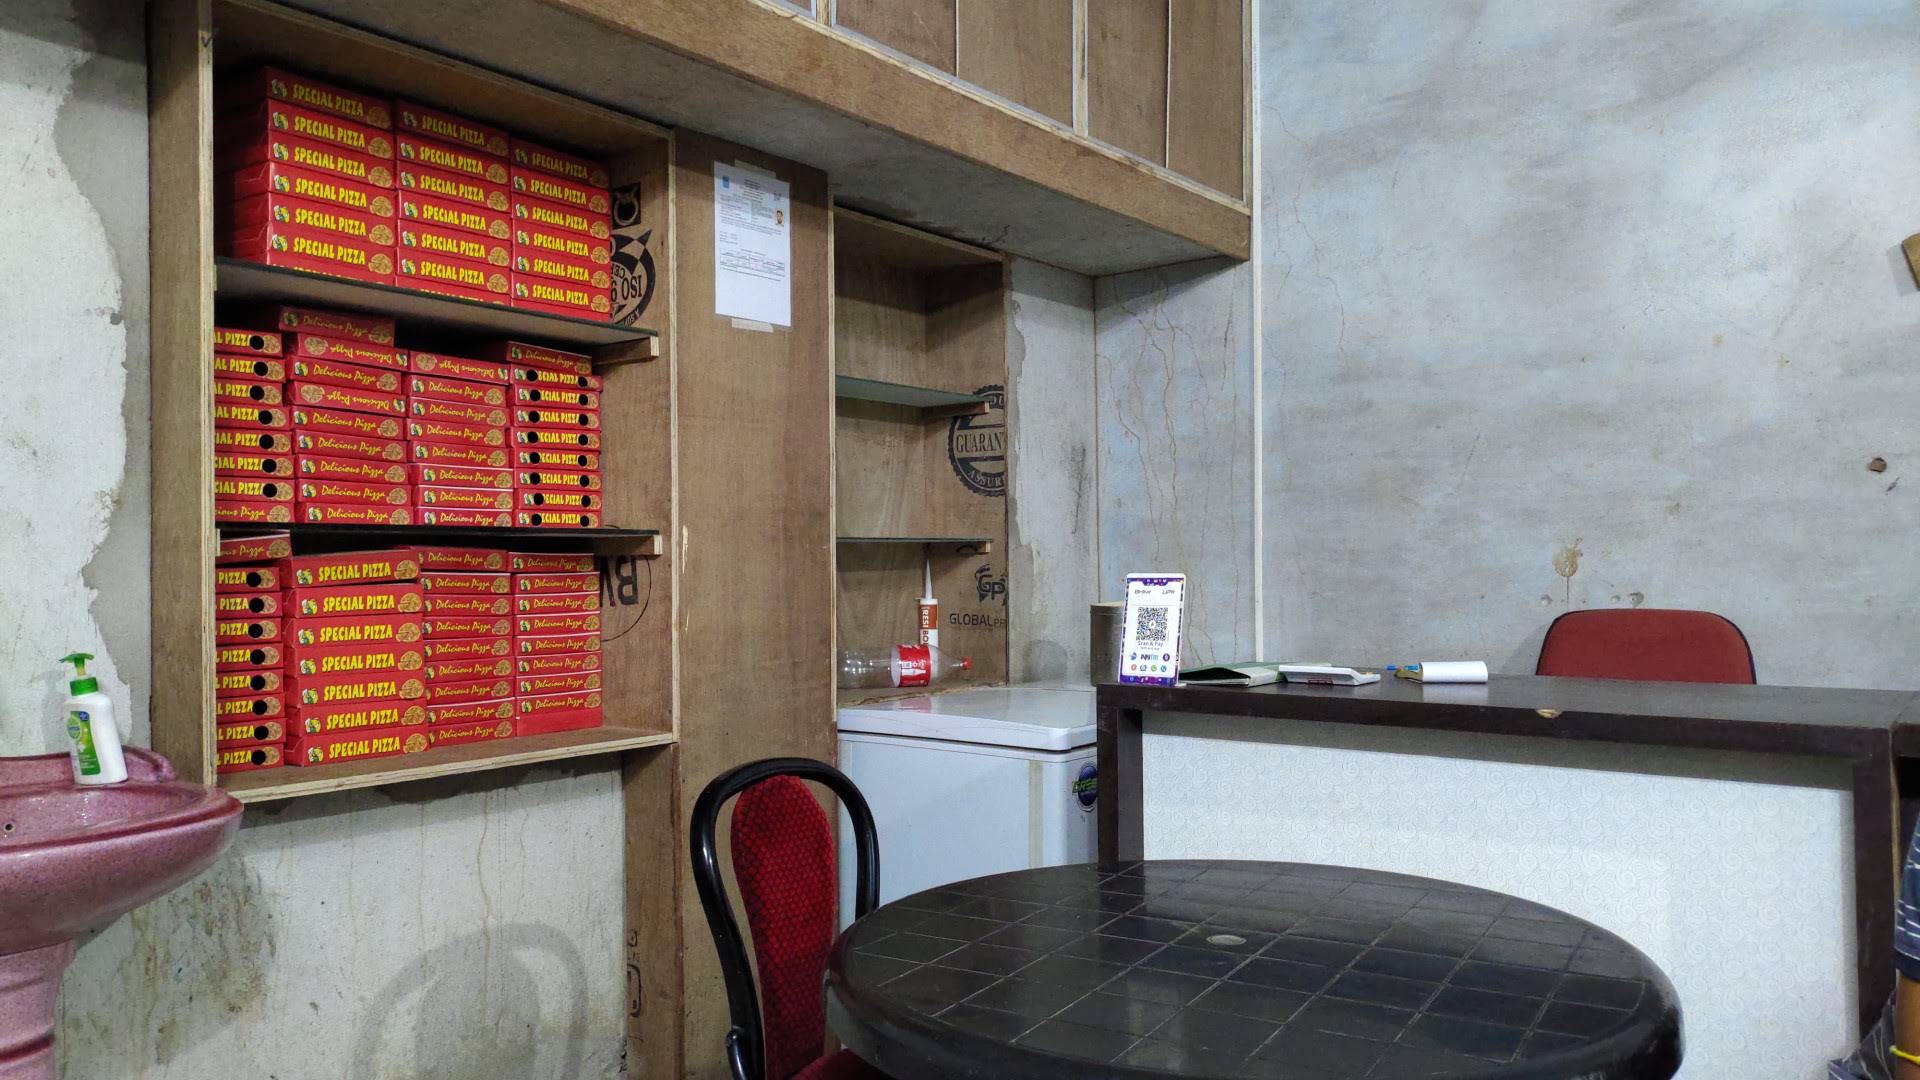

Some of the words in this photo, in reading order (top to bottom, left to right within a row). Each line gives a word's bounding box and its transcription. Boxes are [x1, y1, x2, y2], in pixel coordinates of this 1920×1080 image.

[292, 84, 334, 106] SPECIAL
[336, 95, 364, 116] PIZZA
[294, 114, 335, 138] SPECIAL
[337, 125, 365, 147] PIZZA
[422, 115, 458, 136] SPECIAL
[462, 127, 485, 143] PIZZA
[294, 146, 335, 170] SPECIAL
[338, 157, 365, 177] PIZZA
[419, 146, 455, 168] SPECIAL
[459, 157, 483, 174] PIZZA
[532, 152, 563, 171] SPECIAL
[566, 162, 587, 178] PIZZA
[295, 178, 336, 200] SPECIAL
[338, 187, 366, 207] PIZZA
[420, 174, 456, 195] SPECIAL
[460, 184, 484, 201] PIZZA
[530, 179, 562, 198] SPECIAL
[565, 188, 587, 204] PIZZA
[295, 208, 336, 229] SPECIAL
[338, 217, 366, 235] PIZZA
[422, 204, 458, 225] SPECIAL
[462, 213, 486, 229] PIZZA
[532, 205, 563, 225] SPECIAL
[566, 214, 588, 230] PIZZA
[293, 237, 335, 258] SPECIAL
[337, 246, 365, 264] PIZZA
[421, 232, 457, 252] SPECIAL
[461, 241, 485, 257] PIZZA
[533, 232, 564, 251] SPECIAL
[566, 240, 588, 256] PIZZA
[420, 260, 456, 279] SPECIAL
[460, 267, 484, 283] PIZZA
[534, 257, 564, 276] SPECIAL
[567, 265, 589, 280] PIZZA
[533, 284, 563, 302] SPECIAL
[566, 291, 588, 306] PIZZA
[538, 371, 558, 383] ECIAL
[541, 390, 560, 402] ECIAL
[232, 407, 259, 420] PIZZA
[540, 410, 560, 423] ECIAL
[235, 433, 260, 446] PIZZ
[538, 432, 560, 443] ECIAL
[561, 433, 578, 444] PIZZ
[540, 452, 560, 464] ECIAL
[562, 454, 578, 464] PIZZ
[541, 473, 562, 485] ECIAL
[563, 474, 580, 485] PIZZ
[544, 494, 564, 505] ECIAL
[566, 495, 581, 505] PIZZ
[542, 513, 560, 524] ECIAL
[219, 572, 247, 584] PIZZA
[319, 565, 360, 582] SPECIAL
[362, 562, 391, 578] PIZZA
[220, 597, 249, 610] PIZZA
[323, 596, 364, 612] SPECIAL
[366, 594, 394, 610] PIZZA
[950, 613, 992, 626] GLOBAL
[220, 623, 249, 636] PIZZA
[321, 625, 361, 642] SPECIAL
[364, 624, 393, 640] PIZZA
[222, 649, 251, 662] PIZZA
[322, 655, 363, 672] SPECIAL
[366, 653, 395, 668] PIZZA
[223, 675, 251, 688] PIZZA
[324, 684, 365, 701] SPECIAL
[368, 682, 396, 697] PIZZA
[226, 700, 253, 713] PIZZA
[327, 712, 368, 730] SPECIAL
[370, 708, 399, 725] PIZZA
[226, 725, 254, 739] PIZZA
[224, 750, 252, 764] PIZZA
[329, 741, 370, 759] SPECIAL
[372, 737, 400, 753] PIZZA
